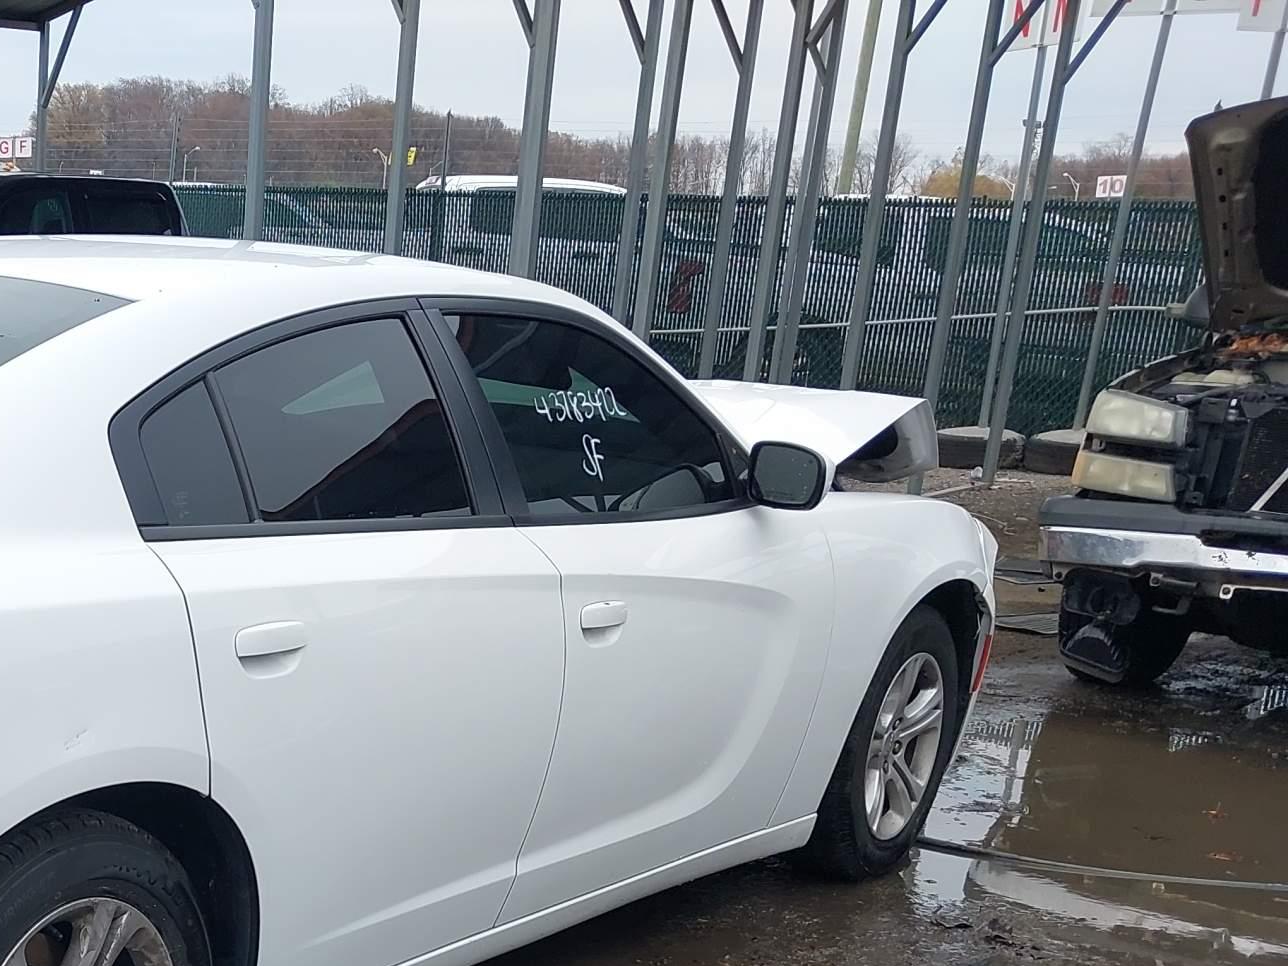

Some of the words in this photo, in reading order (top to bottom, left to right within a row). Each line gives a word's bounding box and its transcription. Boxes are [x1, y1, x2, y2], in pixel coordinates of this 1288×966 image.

[0, 141, 9, 154] G
[19, 140, 27, 154] F
[1098, 179, 1124, 194] 10
[533, 386, 628, 423] 43783422
